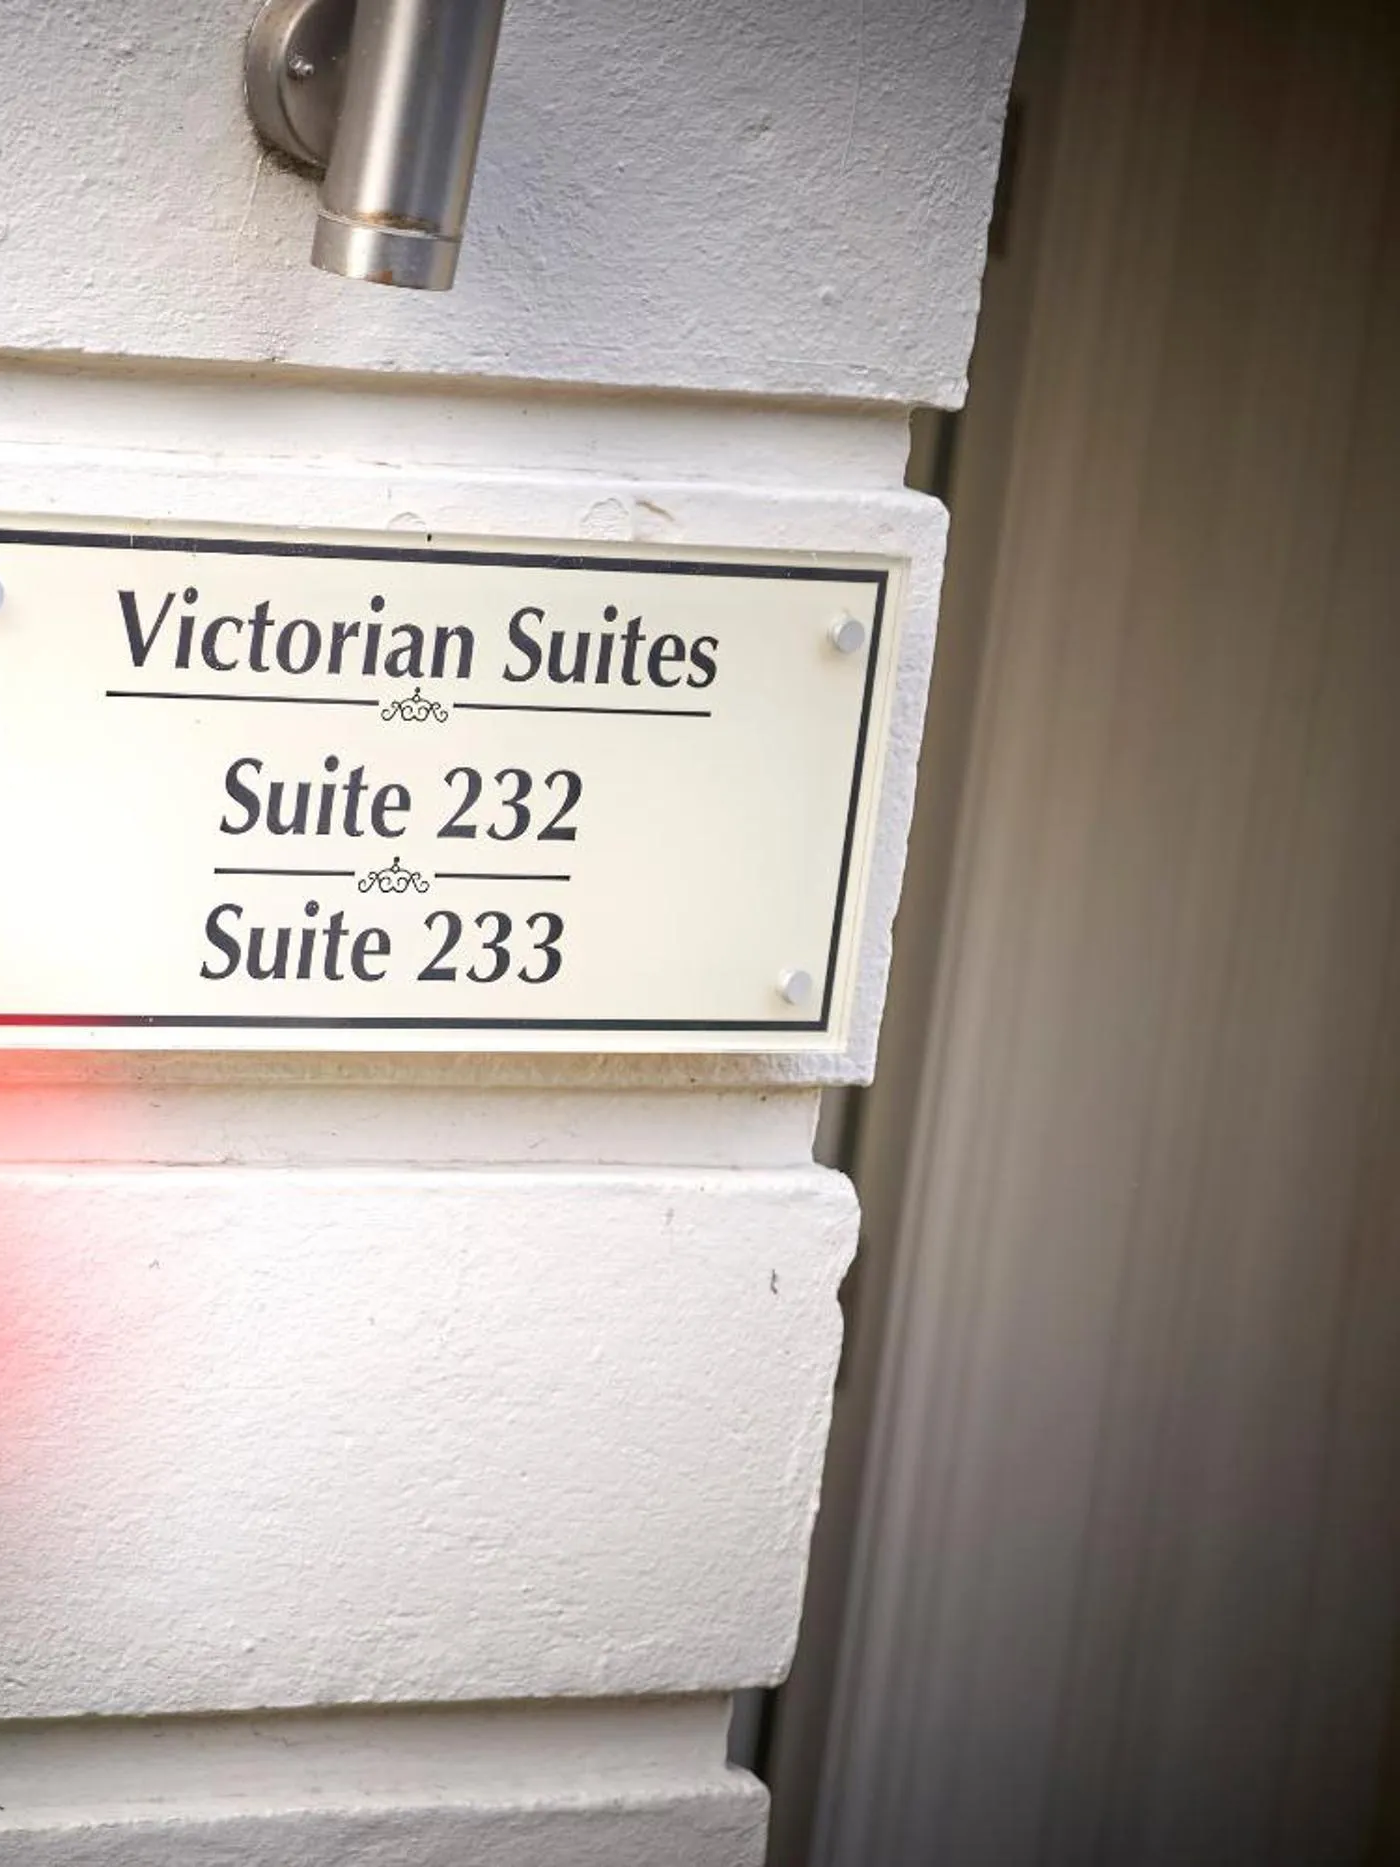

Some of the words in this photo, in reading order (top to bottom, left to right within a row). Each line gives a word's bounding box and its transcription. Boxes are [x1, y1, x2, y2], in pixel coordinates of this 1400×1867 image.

[118, 587, 475, 679] Victorian
[502, 605, 719, 689] Suites
[219, 755, 411, 838] Suite
[436, 767, 582, 841] 232
[200, 900, 391, 982] Suite
[417, 910, 564, 984] 233
